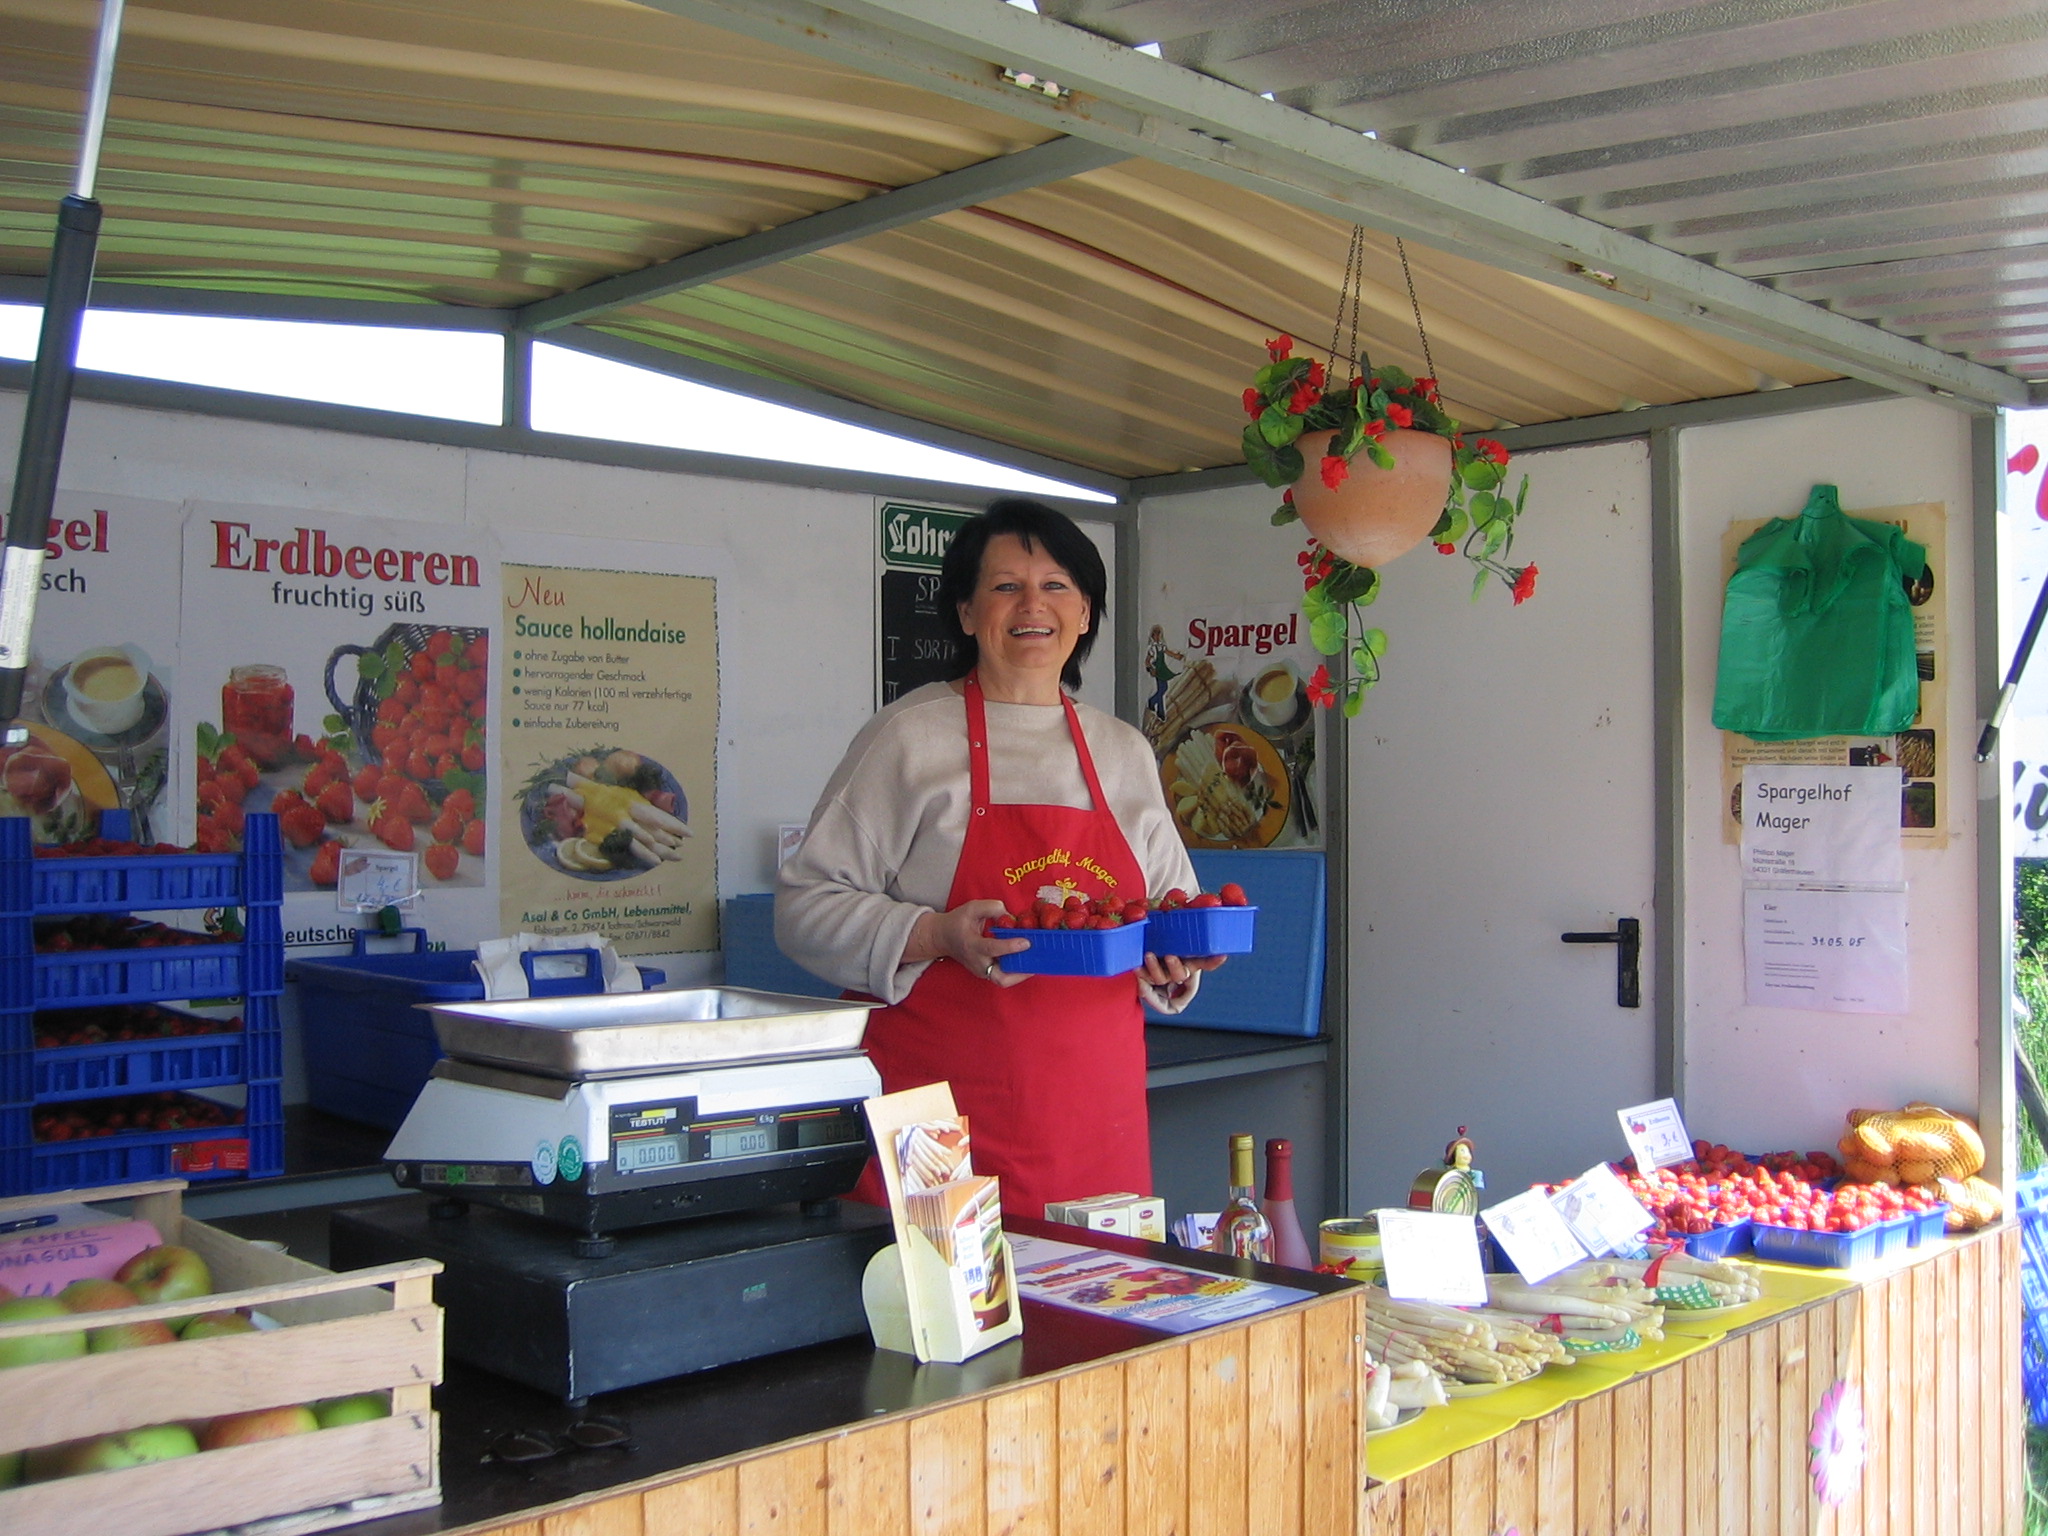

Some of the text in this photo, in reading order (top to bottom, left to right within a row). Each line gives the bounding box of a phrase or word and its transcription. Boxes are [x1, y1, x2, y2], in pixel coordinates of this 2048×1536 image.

[888, 513, 956, 557] Lohr
[211, 519, 480, 587] Erdbeeren
[272, 581, 426, 616] fruchtig süß
[507, 576, 565, 609] Neu
[916, 576, 941, 602] SP
[515, 614, 686, 644] Sauce hollandaise
[1188, 613, 1298, 656] Spargel
[525, 650, 630, 665] ohne Zugabe von Butter
[525, 668, 646, 682] hervorragender Geschmack
[524, 687, 552, 700] wenig
[555, 686, 591, 697] Kalorien
[594, 688, 615, 699] (100
[618, 687, 629, 698] ml
[524, 700, 551, 711] Sauce
[572, 701, 583, 711] 77
[588, 701, 609, 713] kcal)
[524, 716, 619, 732] einfache Zubereitung
[1757, 783, 1852, 804] Spargelhof
[1755, 812, 1811, 833] Mager
[1004, 848, 1118, 888] Spargelhof Mager
[521, 902, 692, 923] Asal & Co GmbH, Lebensmittel,
[285, 925, 357, 943] eutsche
[739, 1133, 766, 1151] 0.00
[638, 1144, 676, 1165] 0.000
